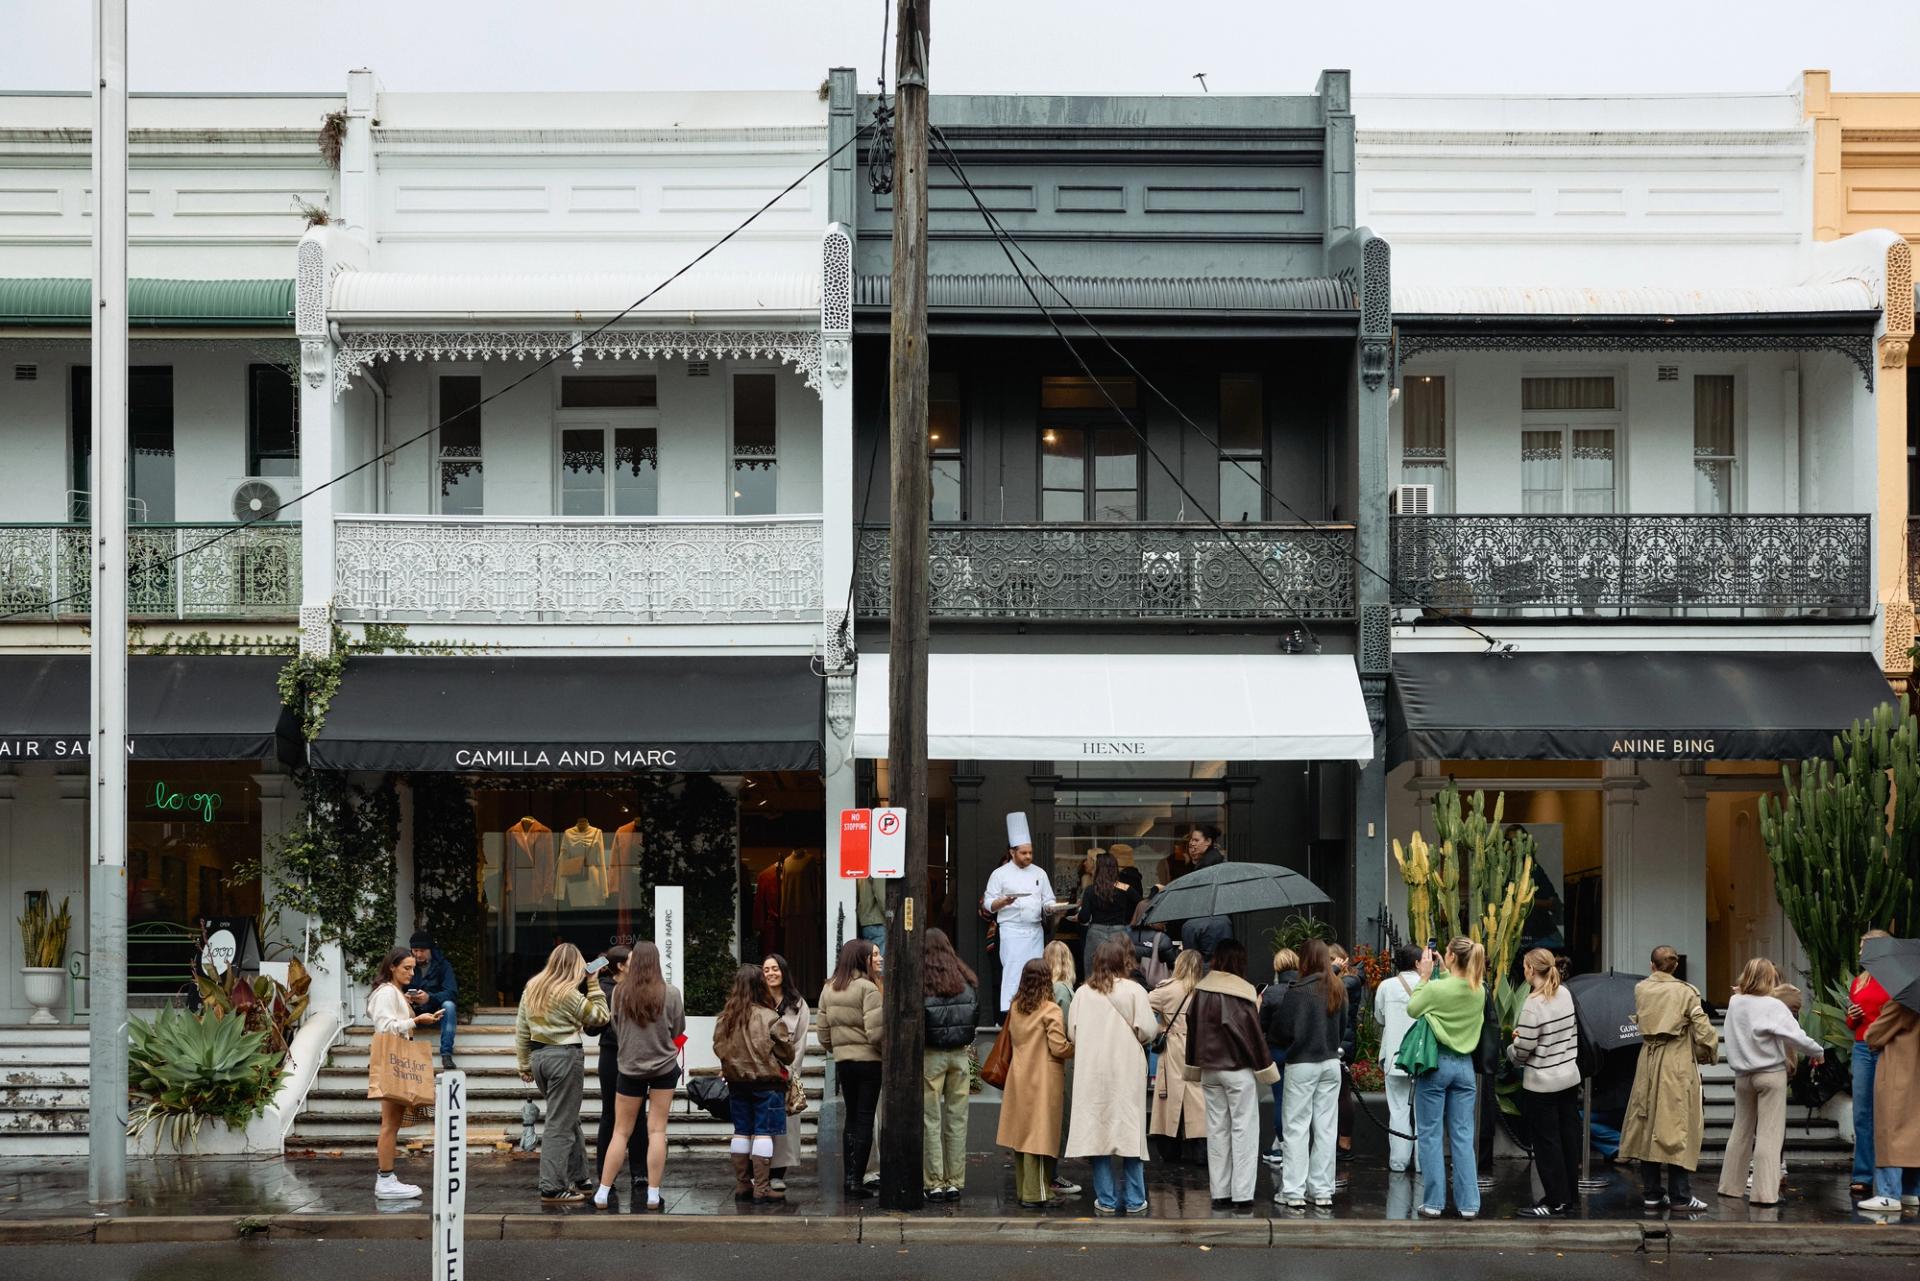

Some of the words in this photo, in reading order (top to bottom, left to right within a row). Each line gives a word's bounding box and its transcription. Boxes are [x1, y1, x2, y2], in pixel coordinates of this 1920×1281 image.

[0, 741, 39, 756] AIR
[55, 740, 135, 756] SALN
[1083, 742, 1145, 754] HENNE
[1612, 739, 1666, 753] ANINE
[1673, 739, 1715, 753] BING
[455, 749, 550, 766] CAMILLA
[558, 750, 605, 766] AND
[614, 750, 677, 766] MARC
[145, 781, 222, 822] loop
[851, 813, 861, 821] NO
[1053, 811, 1101, 821] HENNE
[844, 822, 867, 831] STOPPING
[448, 1084, 461, 1204] KEEP
[446, 1228, 458, 1281] LE
